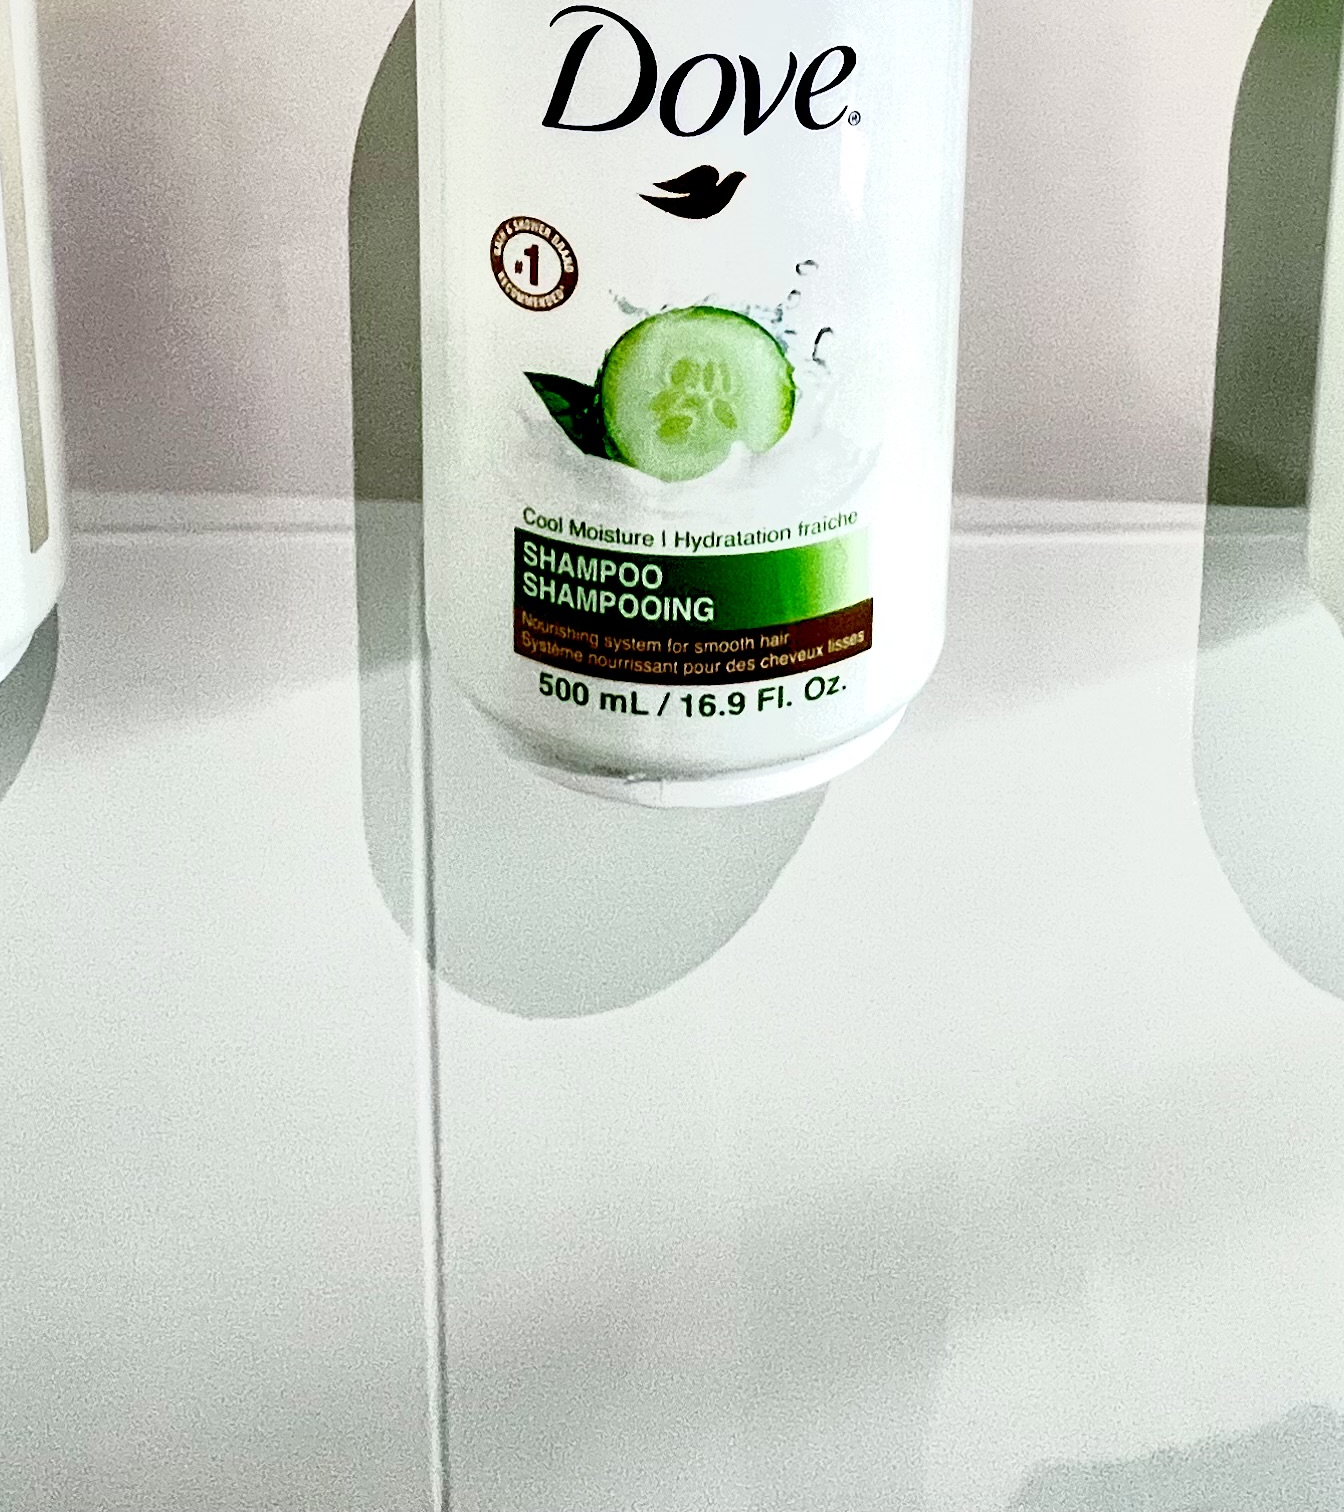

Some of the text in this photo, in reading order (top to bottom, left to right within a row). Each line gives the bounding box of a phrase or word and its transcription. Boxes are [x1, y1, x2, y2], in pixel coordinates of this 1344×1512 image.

[542, 5, 857, 137] Dove
[522, 506, 563, 534] Cool
[568, 518, 655, 548] Moisture
[674, 526, 791, 553] Hydratation
[523, 540, 663, 589] SHAMPOO
[522, 571, 715, 621] SHAMPOOING
[521, 610, 790, 655] Nourishing system for smooth hair
[588, 653, 678, 675] nourrissant
[683, 661, 722, 677] pour
[726, 657, 756, 674] des
[759, 644, 824, 669] cheveux
[827, 629, 865, 654] lisses
[539, 671, 847, 718] 500 mL / 16.9 Fl. Oz.
